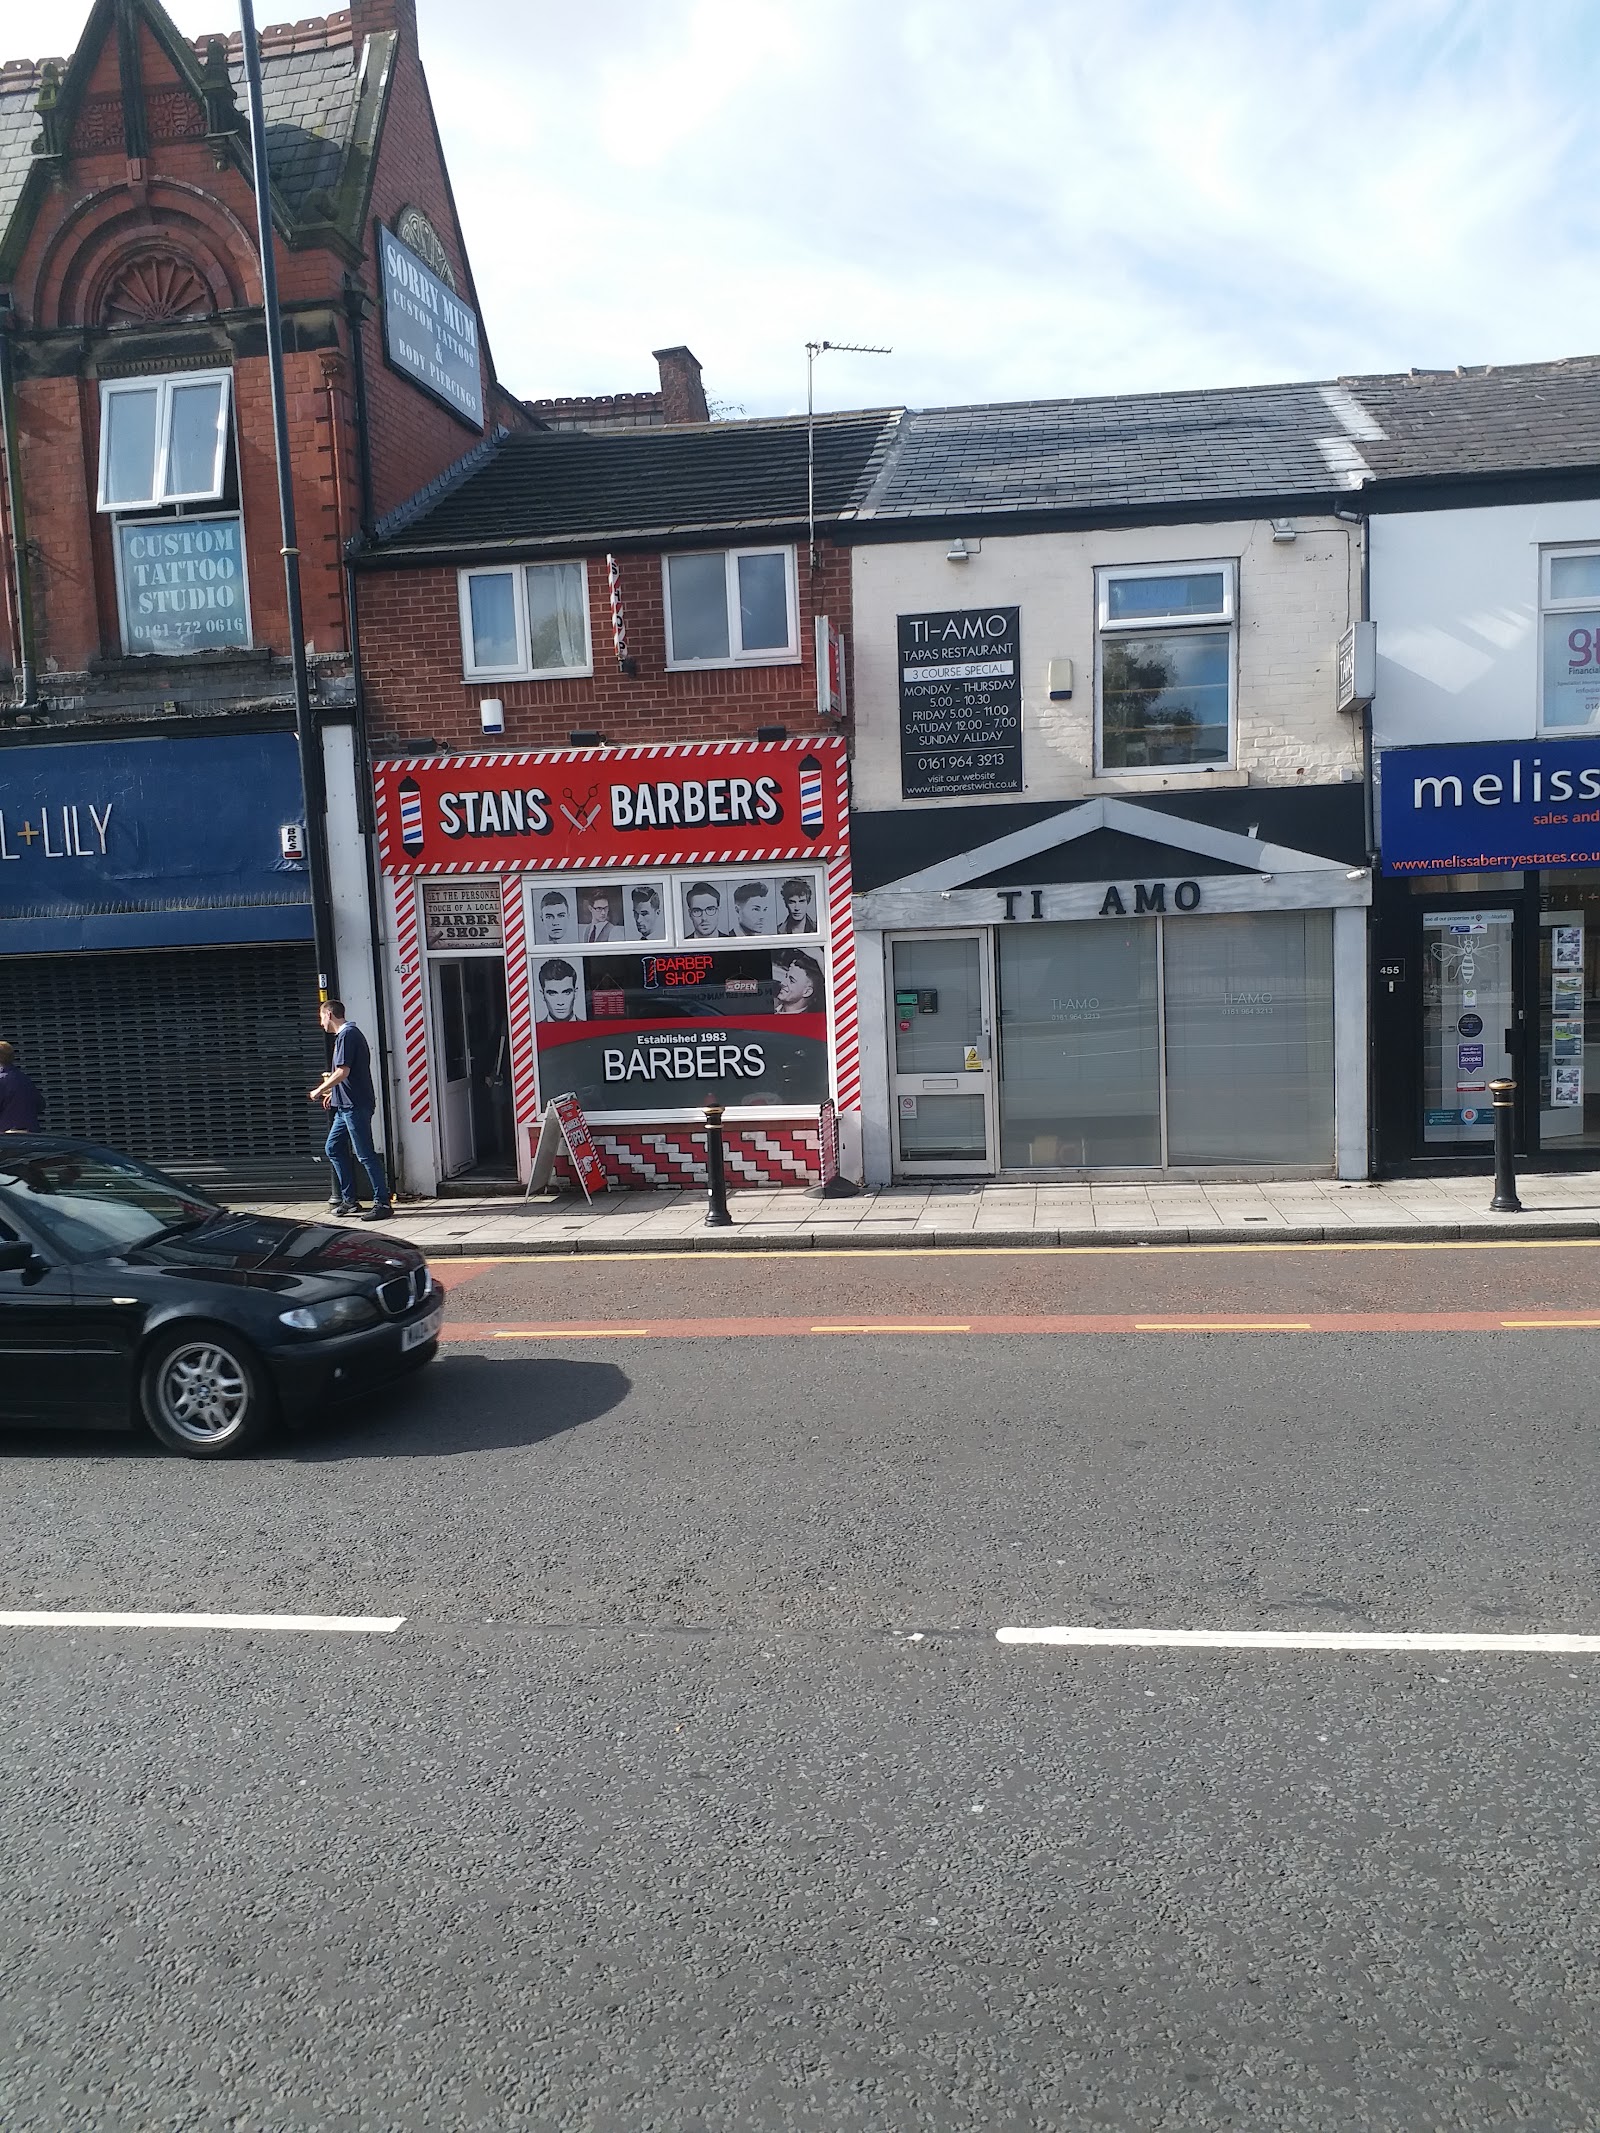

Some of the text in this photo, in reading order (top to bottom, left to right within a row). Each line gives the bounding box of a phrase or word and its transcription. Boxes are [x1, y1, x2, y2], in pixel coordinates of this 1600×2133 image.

[386, 244, 476, 349] SORRY MUM
[393, 288, 474, 368] CUSTOM TATTOOS
[435, 342, 443, 365] &
[399, 338, 476, 411] BODY PIERCINGS
[130, 528, 234, 558] CUSTOM
[134, 557, 234, 587] TATTOO
[139, 585, 234, 614] STUDIO
[134, 617, 244, 639] 0161 772 0616
[909, 614, 1007, 643] TI-AMO
[904, 643, 1013, 662] TAPAS RESTAURANT
[912, 664, 1005, 680] 3 COURSE SPECIAL
[904, 684, 952, 697] MONDAY
[963, 679, 1016, 693] THURSDAY
[930, 696, 953, 708] 5.00
[963, 694, 990, 706] 10.30
[912, 709, 947, 721] FRIDAY
[949, 707, 973, 719] 5.00
[984, 705, 1009, 717] 11.00
[905, 722, 953, 735] SATUDAY
[956, 719, 983, 732] 12.00
[993, 717, 1017, 729] 7.00
[918, 731, 1004, 746] SUNDAY ALLDAY
[918, 753, 1005, 770] 0161 964 3213
[927, 771, 996, 784] visit our website
[1413, 759, 1600, 808] meliss
[906, 779, 1018, 794] www.tiamoprestwich.co.uk
[439, 776, 781, 836] STANS BARBERS
[1533, 810, 1600, 825] sales and
[1392, 851, 1600, 870] www.melissaberryestates.co.u
[427, 890, 500, 901] GET THE PERSONAL
[997, 880, 1201, 920] TI AMO
[428, 904, 451, 913] TOUCH
[454, 904, 464, 912] OF
[475, 903, 499, 911] LOCAL
[430, 914, 500, 927] BARBER
[446, 927, 489, 938] SHOP
[656, 955, 714, 971] BARBER
[1379, 966, 1400, 975] 455
[665, 971, 706, 986] SHOP
[734, 982, 757, 990] OPEN
[1051, 997, 1100, 1010] TI-AMO
[1221, 992, 1273, 1005] TI-AMO
[637, 1032, 727, 1045] Established 1983
[603, 1044, 766, 1083] BARBERS
